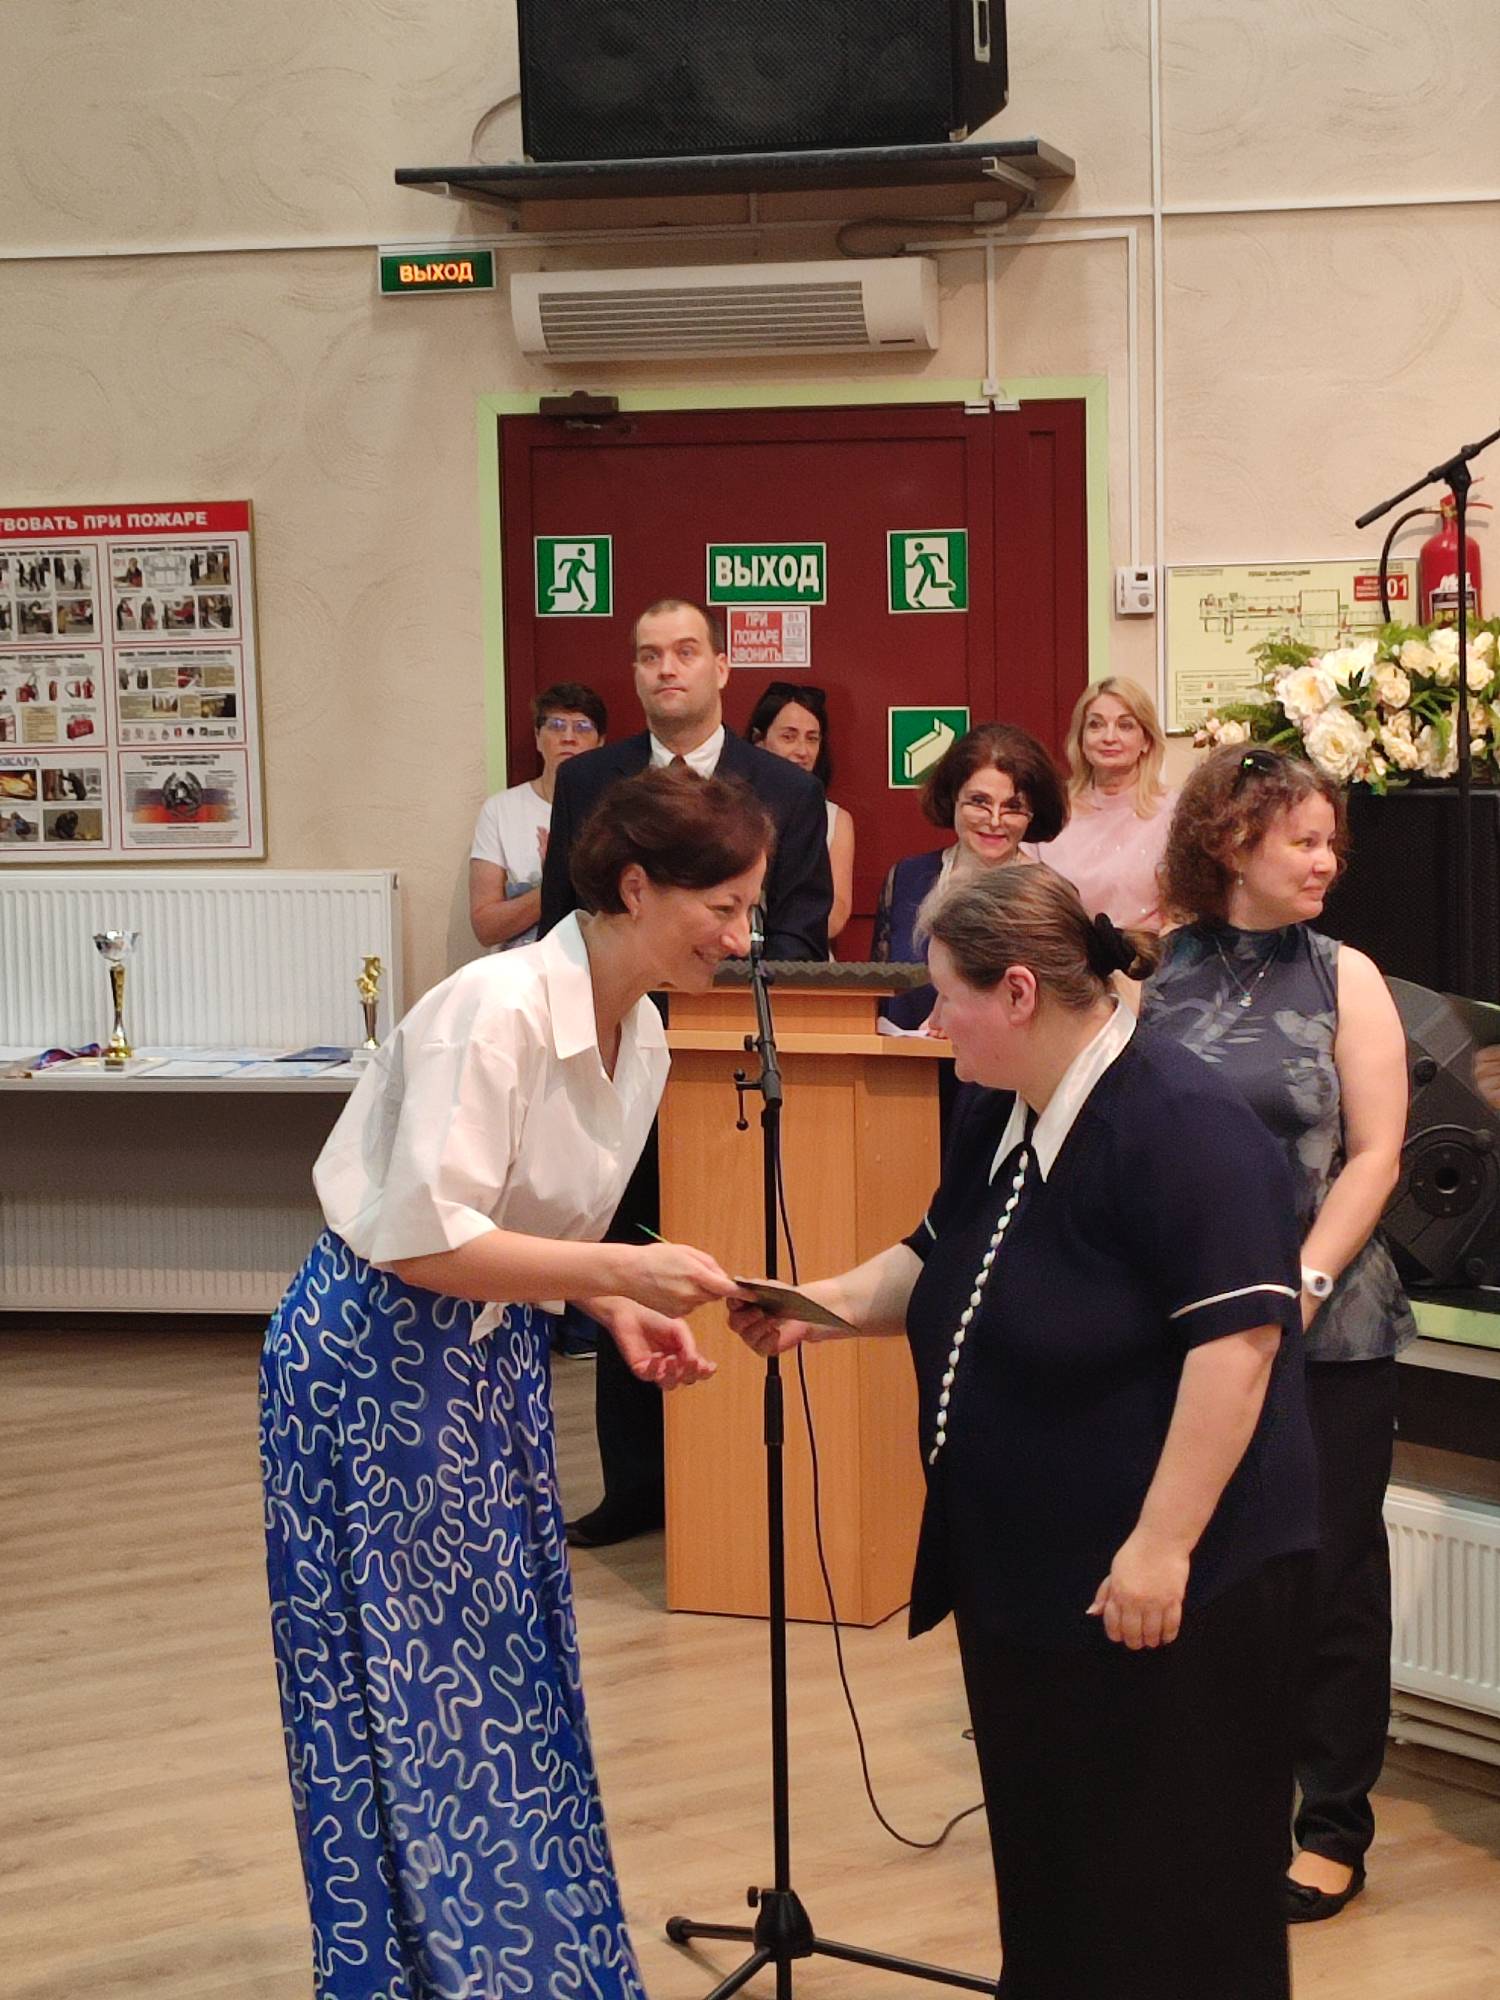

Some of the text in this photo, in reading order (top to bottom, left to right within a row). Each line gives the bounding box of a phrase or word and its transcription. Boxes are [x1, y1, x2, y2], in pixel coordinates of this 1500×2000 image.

[399, 262, 473, 283] ВЫХОД
[83, 514, 122, 529] ПРИ
[128, 511, 208, 528] ПОЖАРЕ
[715, 555, 820, 593] ВЫХОД
[1387, 577, 1408, 598] 01
[745, 611, 768, 627] ПРИ
[734, 629, 779, 645] ПОЖАРЕ
[731, 647, 782, 662] ЗВОНИТЬ
